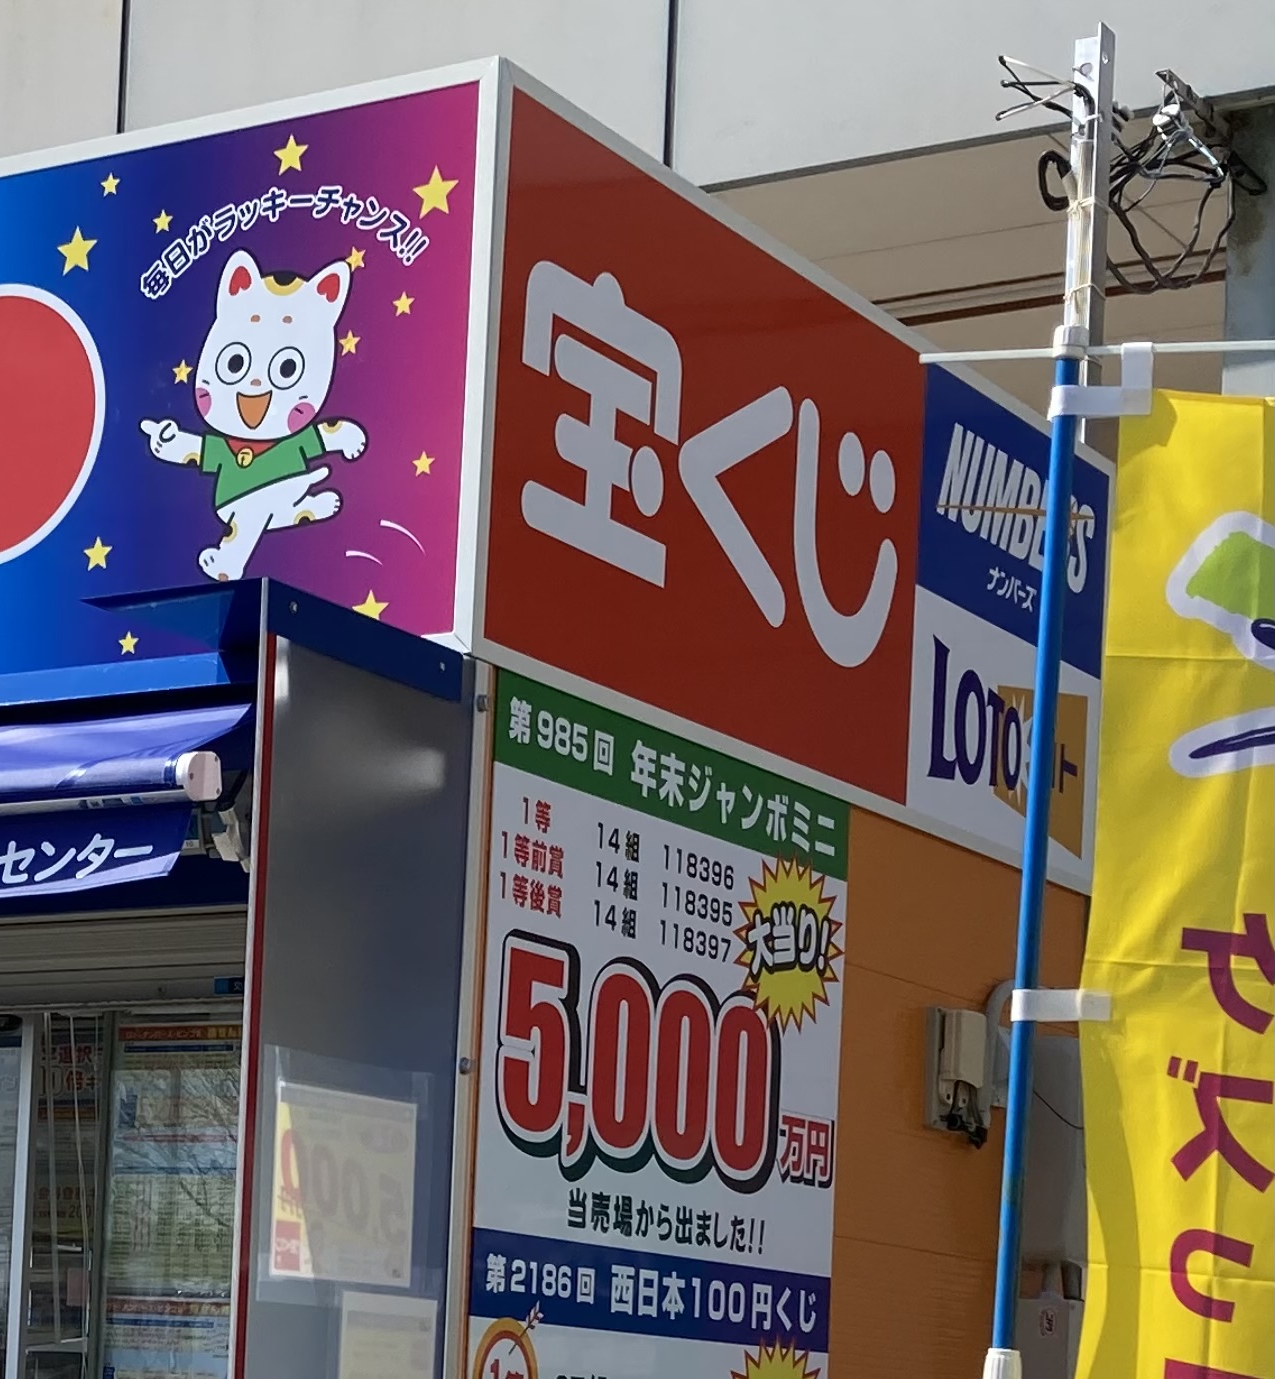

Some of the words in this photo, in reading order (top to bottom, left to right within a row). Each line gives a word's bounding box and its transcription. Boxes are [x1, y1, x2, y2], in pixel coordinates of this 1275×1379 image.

[140, 184, 430, 299] 毎日がラッキーチャンス!!
[521, 260, 898, 669] 宝くじ
[937, 422, 1096, 594] NUMBES
[987, 566, 1037, 612] ナンバーズ
[509, 696, 614, 775] 第985回
[631, 740, 835, 856] 年末ジャンボミニ
[501, 831, 564, 879] 1等前賞
[596, 861, 638, 901] 14組
[662, 882, 733, 926] 118395
[523, 797, 551, 833] 1等
[598, 822, 640, 863] 14組
[663, 844, 734, 890] 118396
[500, 872, 562, 918] 1等後賞
[594, 900, 637, 939] 14組
[660, 920, 731, 962] 118397
[746, 902, 832, 975] 大当り!
[498, 935, 773, 1182] 5,000
[778, 1113, 833, 1187] 万円
[567, 1188, 765, 1254] 当売場から出ました!!
[485, 1253, 594, 1304] 第2186回
[610, 1266, 817, 1332] 西日本100円くじ
